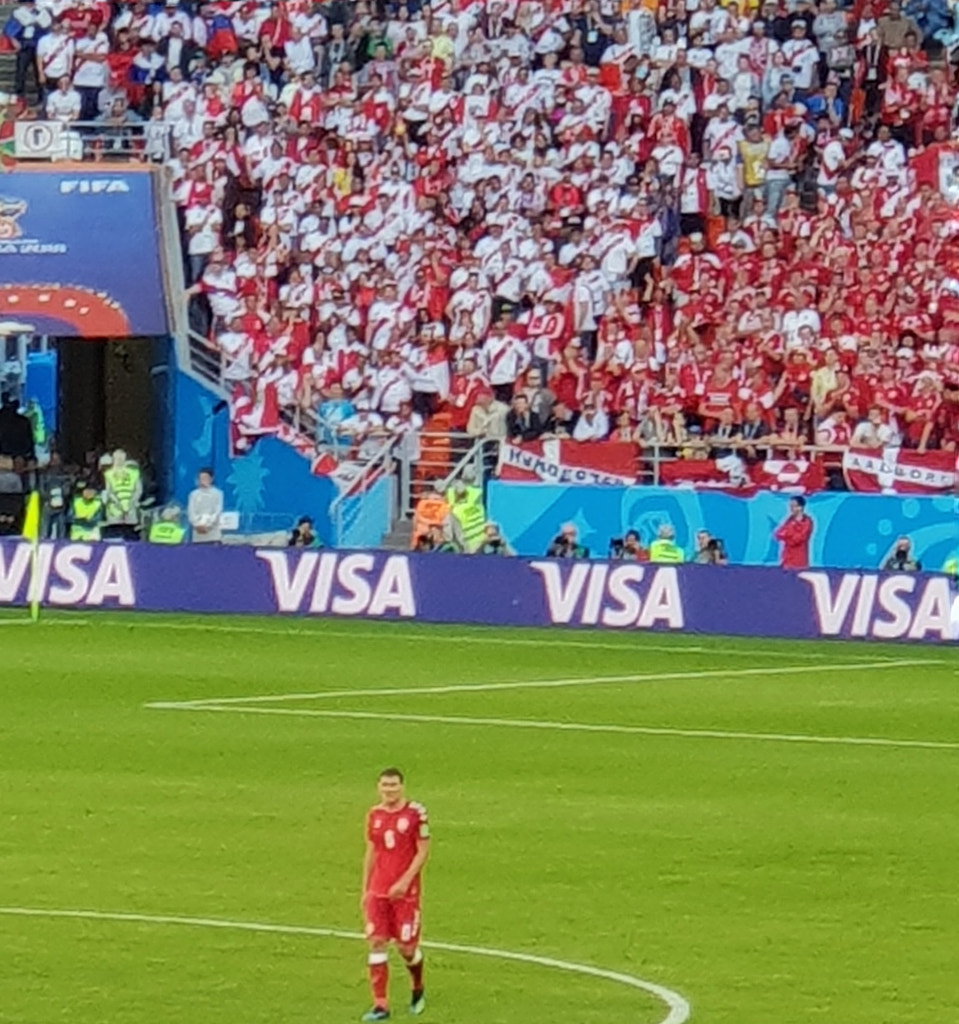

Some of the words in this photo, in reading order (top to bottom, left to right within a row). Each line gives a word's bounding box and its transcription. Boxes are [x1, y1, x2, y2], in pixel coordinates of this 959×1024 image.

[60, 180, 130, 193] FIFA
[255, 549, 417, 618] VISA
[530, 560, 684, 630] VISA
[798, 570, 959, 642] VISA
